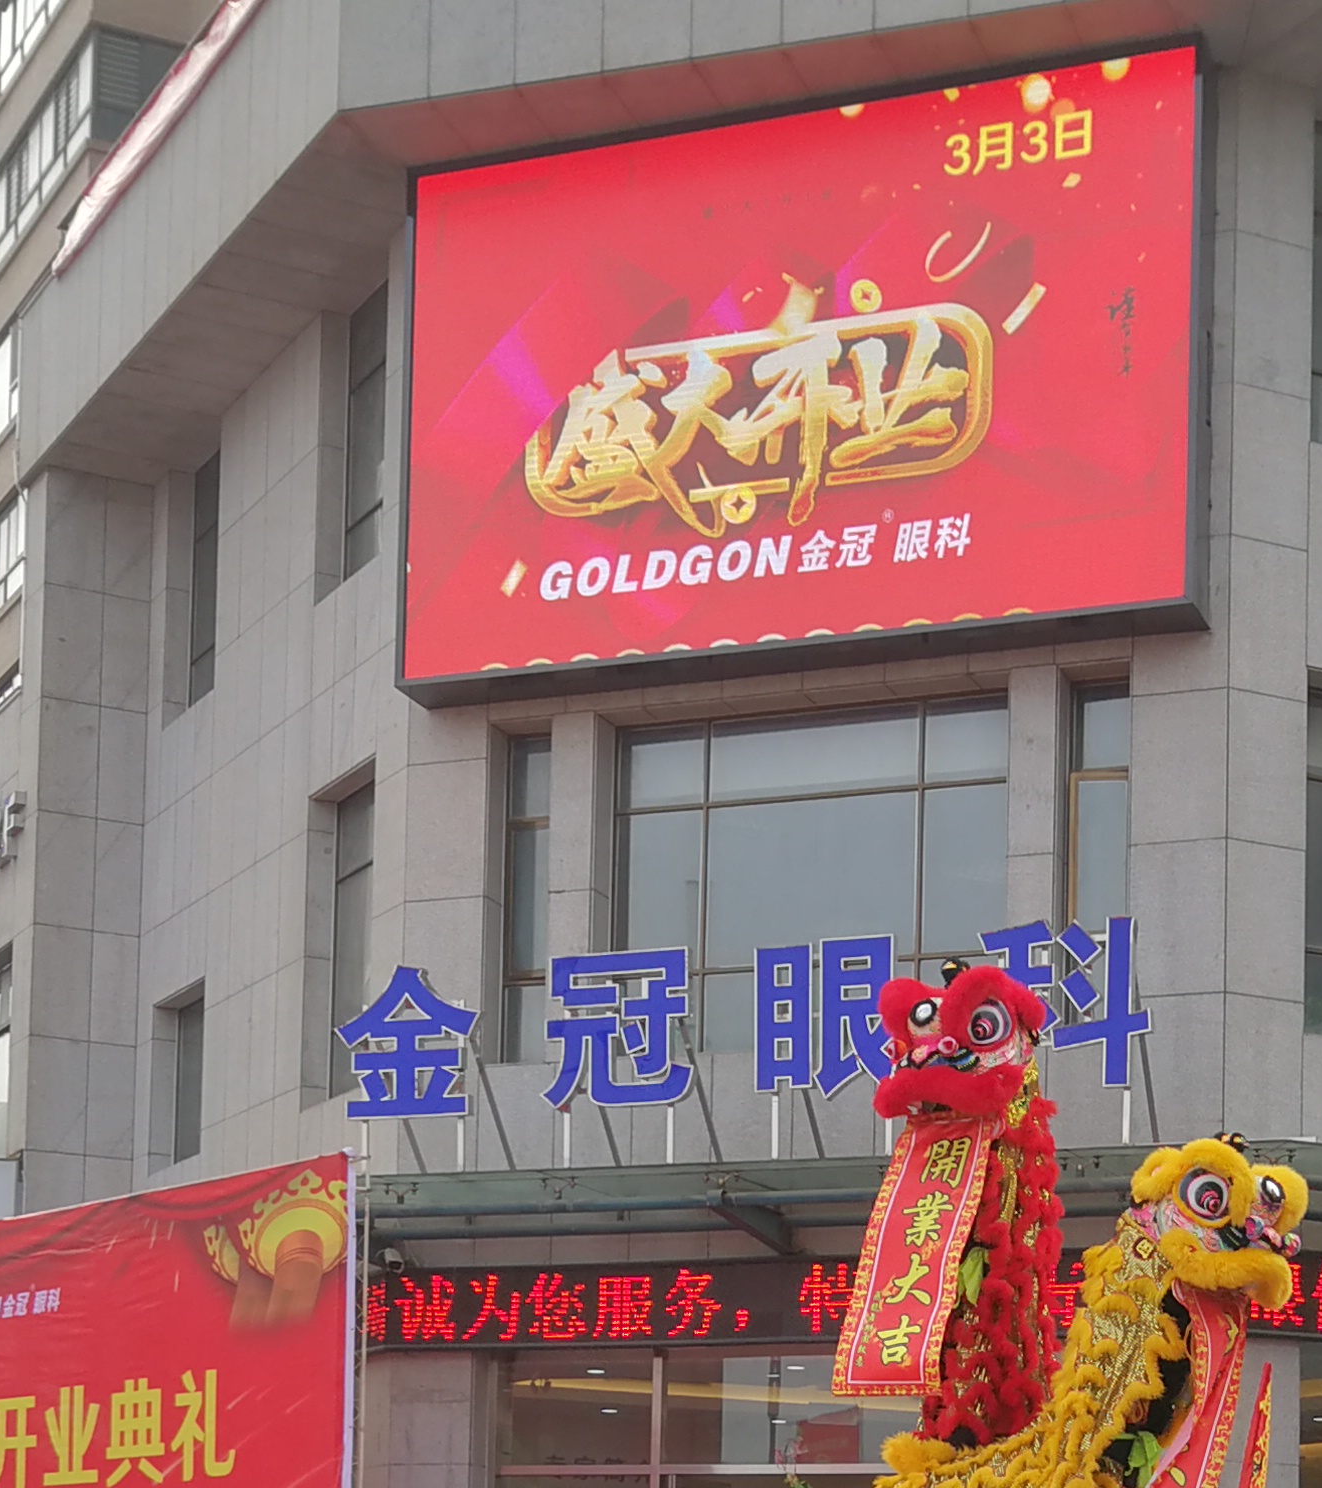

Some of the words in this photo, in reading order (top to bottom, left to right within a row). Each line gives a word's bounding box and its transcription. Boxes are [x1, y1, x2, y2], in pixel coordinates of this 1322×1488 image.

[943, 109, 1093, 177] 3月3日
[539, 535, 793, 602] GOLDGON
[796, 523, 877, 574] 金冠
[892, 512, 973, 564] 眼科
[335, 915, 1152, 1120] 金冠眼科
[884, 1136, 972, 1366] 開業大吉
[2, 1291, 30, 1319] 金冠
[32, 1287, 62, 1315] 眼科
